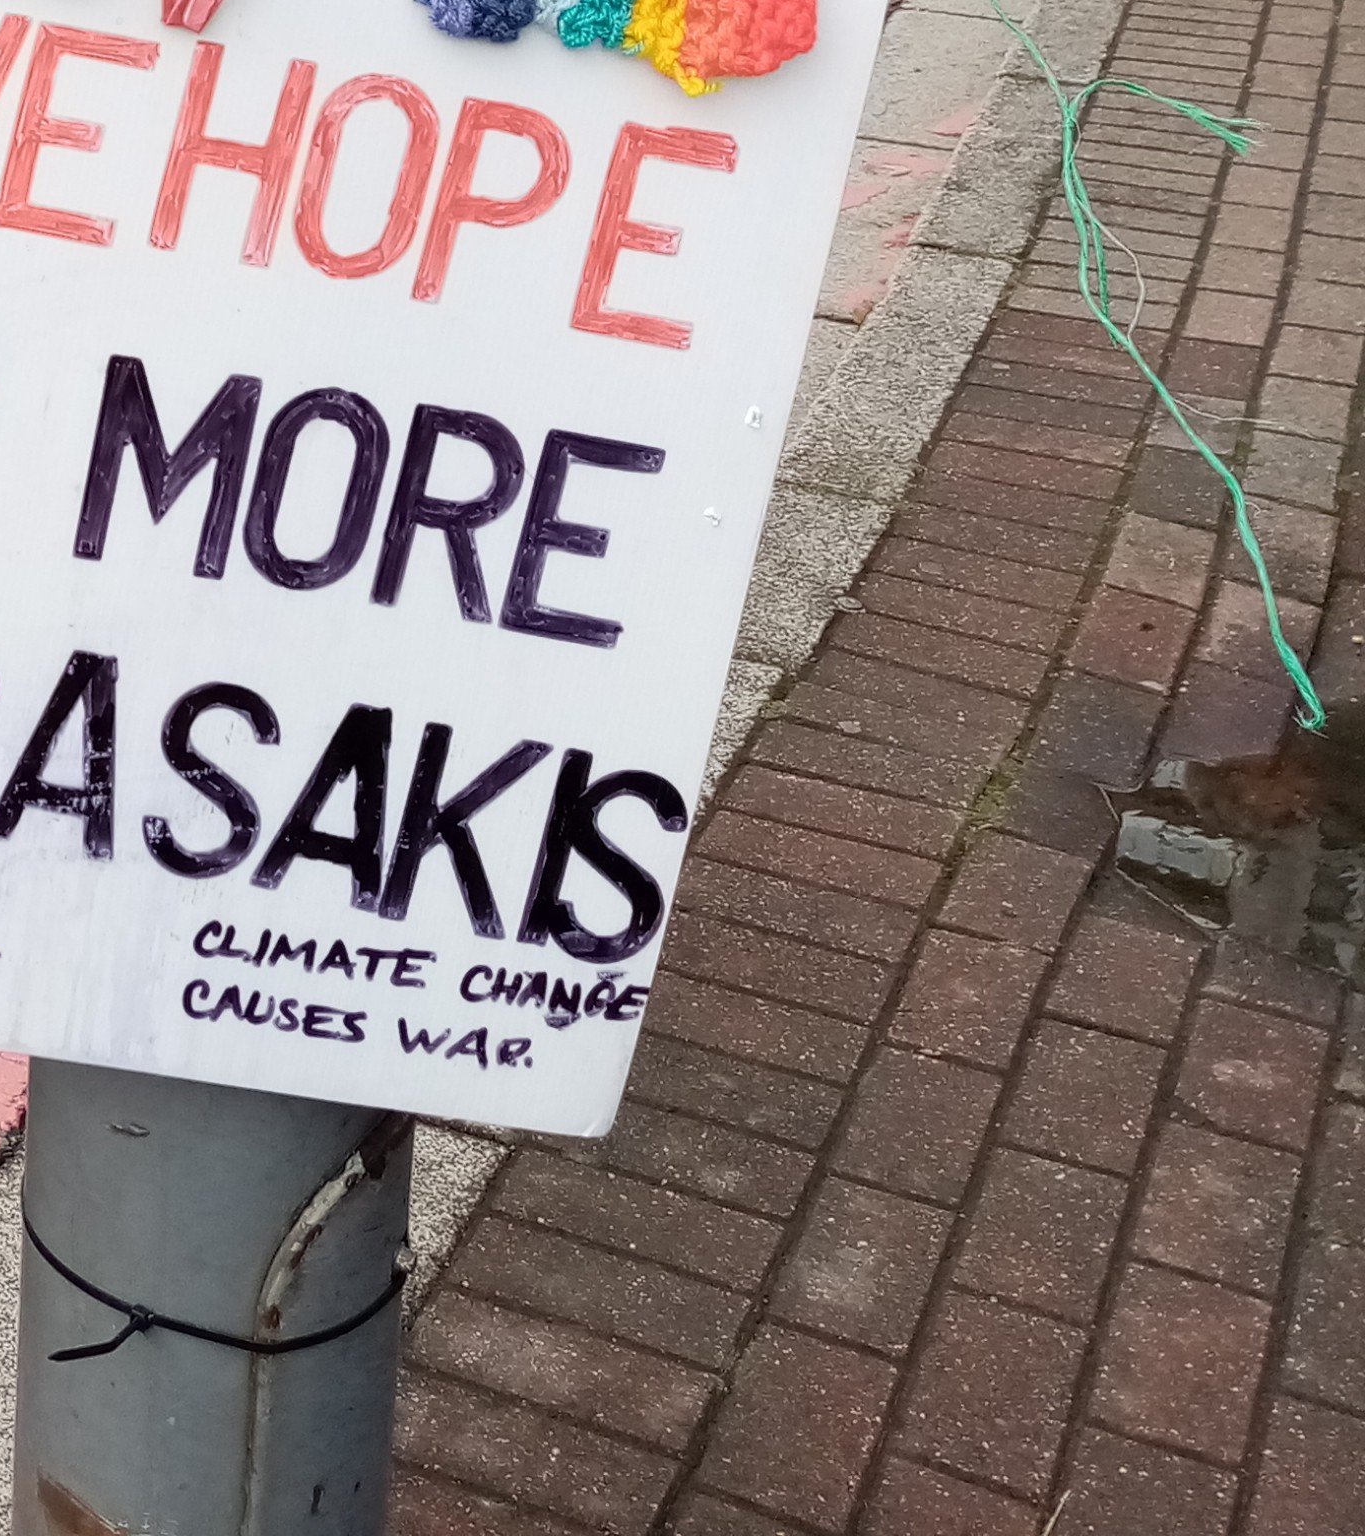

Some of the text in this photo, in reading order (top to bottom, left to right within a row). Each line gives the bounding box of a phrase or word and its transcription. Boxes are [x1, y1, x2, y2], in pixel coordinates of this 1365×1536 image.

[149, 40, 738, 349] HOPE
[73, 354, 667, 649] MORE
[182, 978, 368, 1044] CAUSES
[192, 919, 651, 1032] CLIMATE CHANGE
